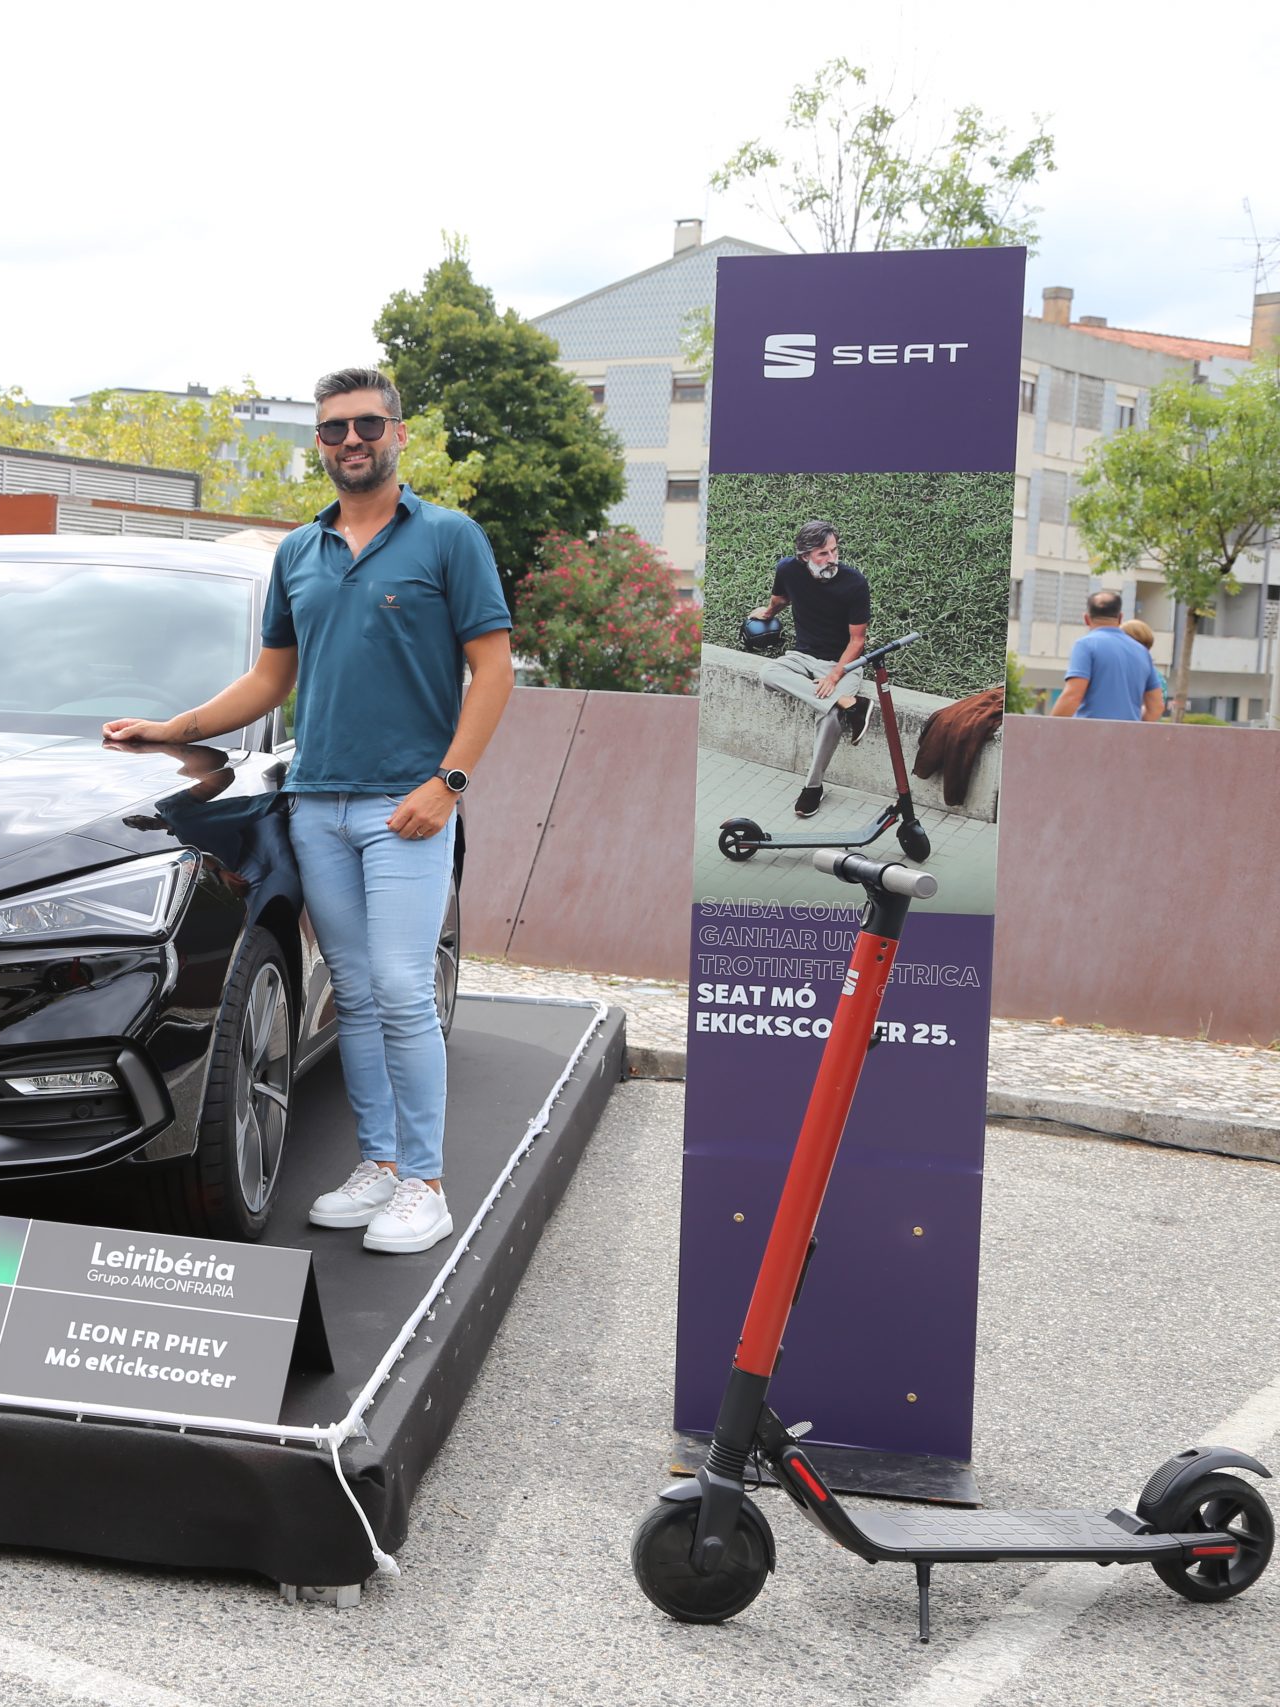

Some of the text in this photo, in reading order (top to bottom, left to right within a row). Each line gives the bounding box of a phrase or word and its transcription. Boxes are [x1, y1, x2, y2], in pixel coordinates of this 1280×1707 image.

[832, 343, 969, 365] SEAT
[700, 895, 784, 920] SAIBA
[698, 924, 817, 950] GANHAR
[697, 953, 846, 981] TROTINETE
[697, 982, 817, 1009] SEAT MÓ
[912, 1023, 957, 1046] 25.
[90, 1241, 235, 1281] Leiribéria
[86, 1269, 235, 1299] Grupo AMCONFRARIA
[67, 1321, 229, 1358] LEON FR PHEV
[44, 1346, 237, 1389] Mó eKickscooter
